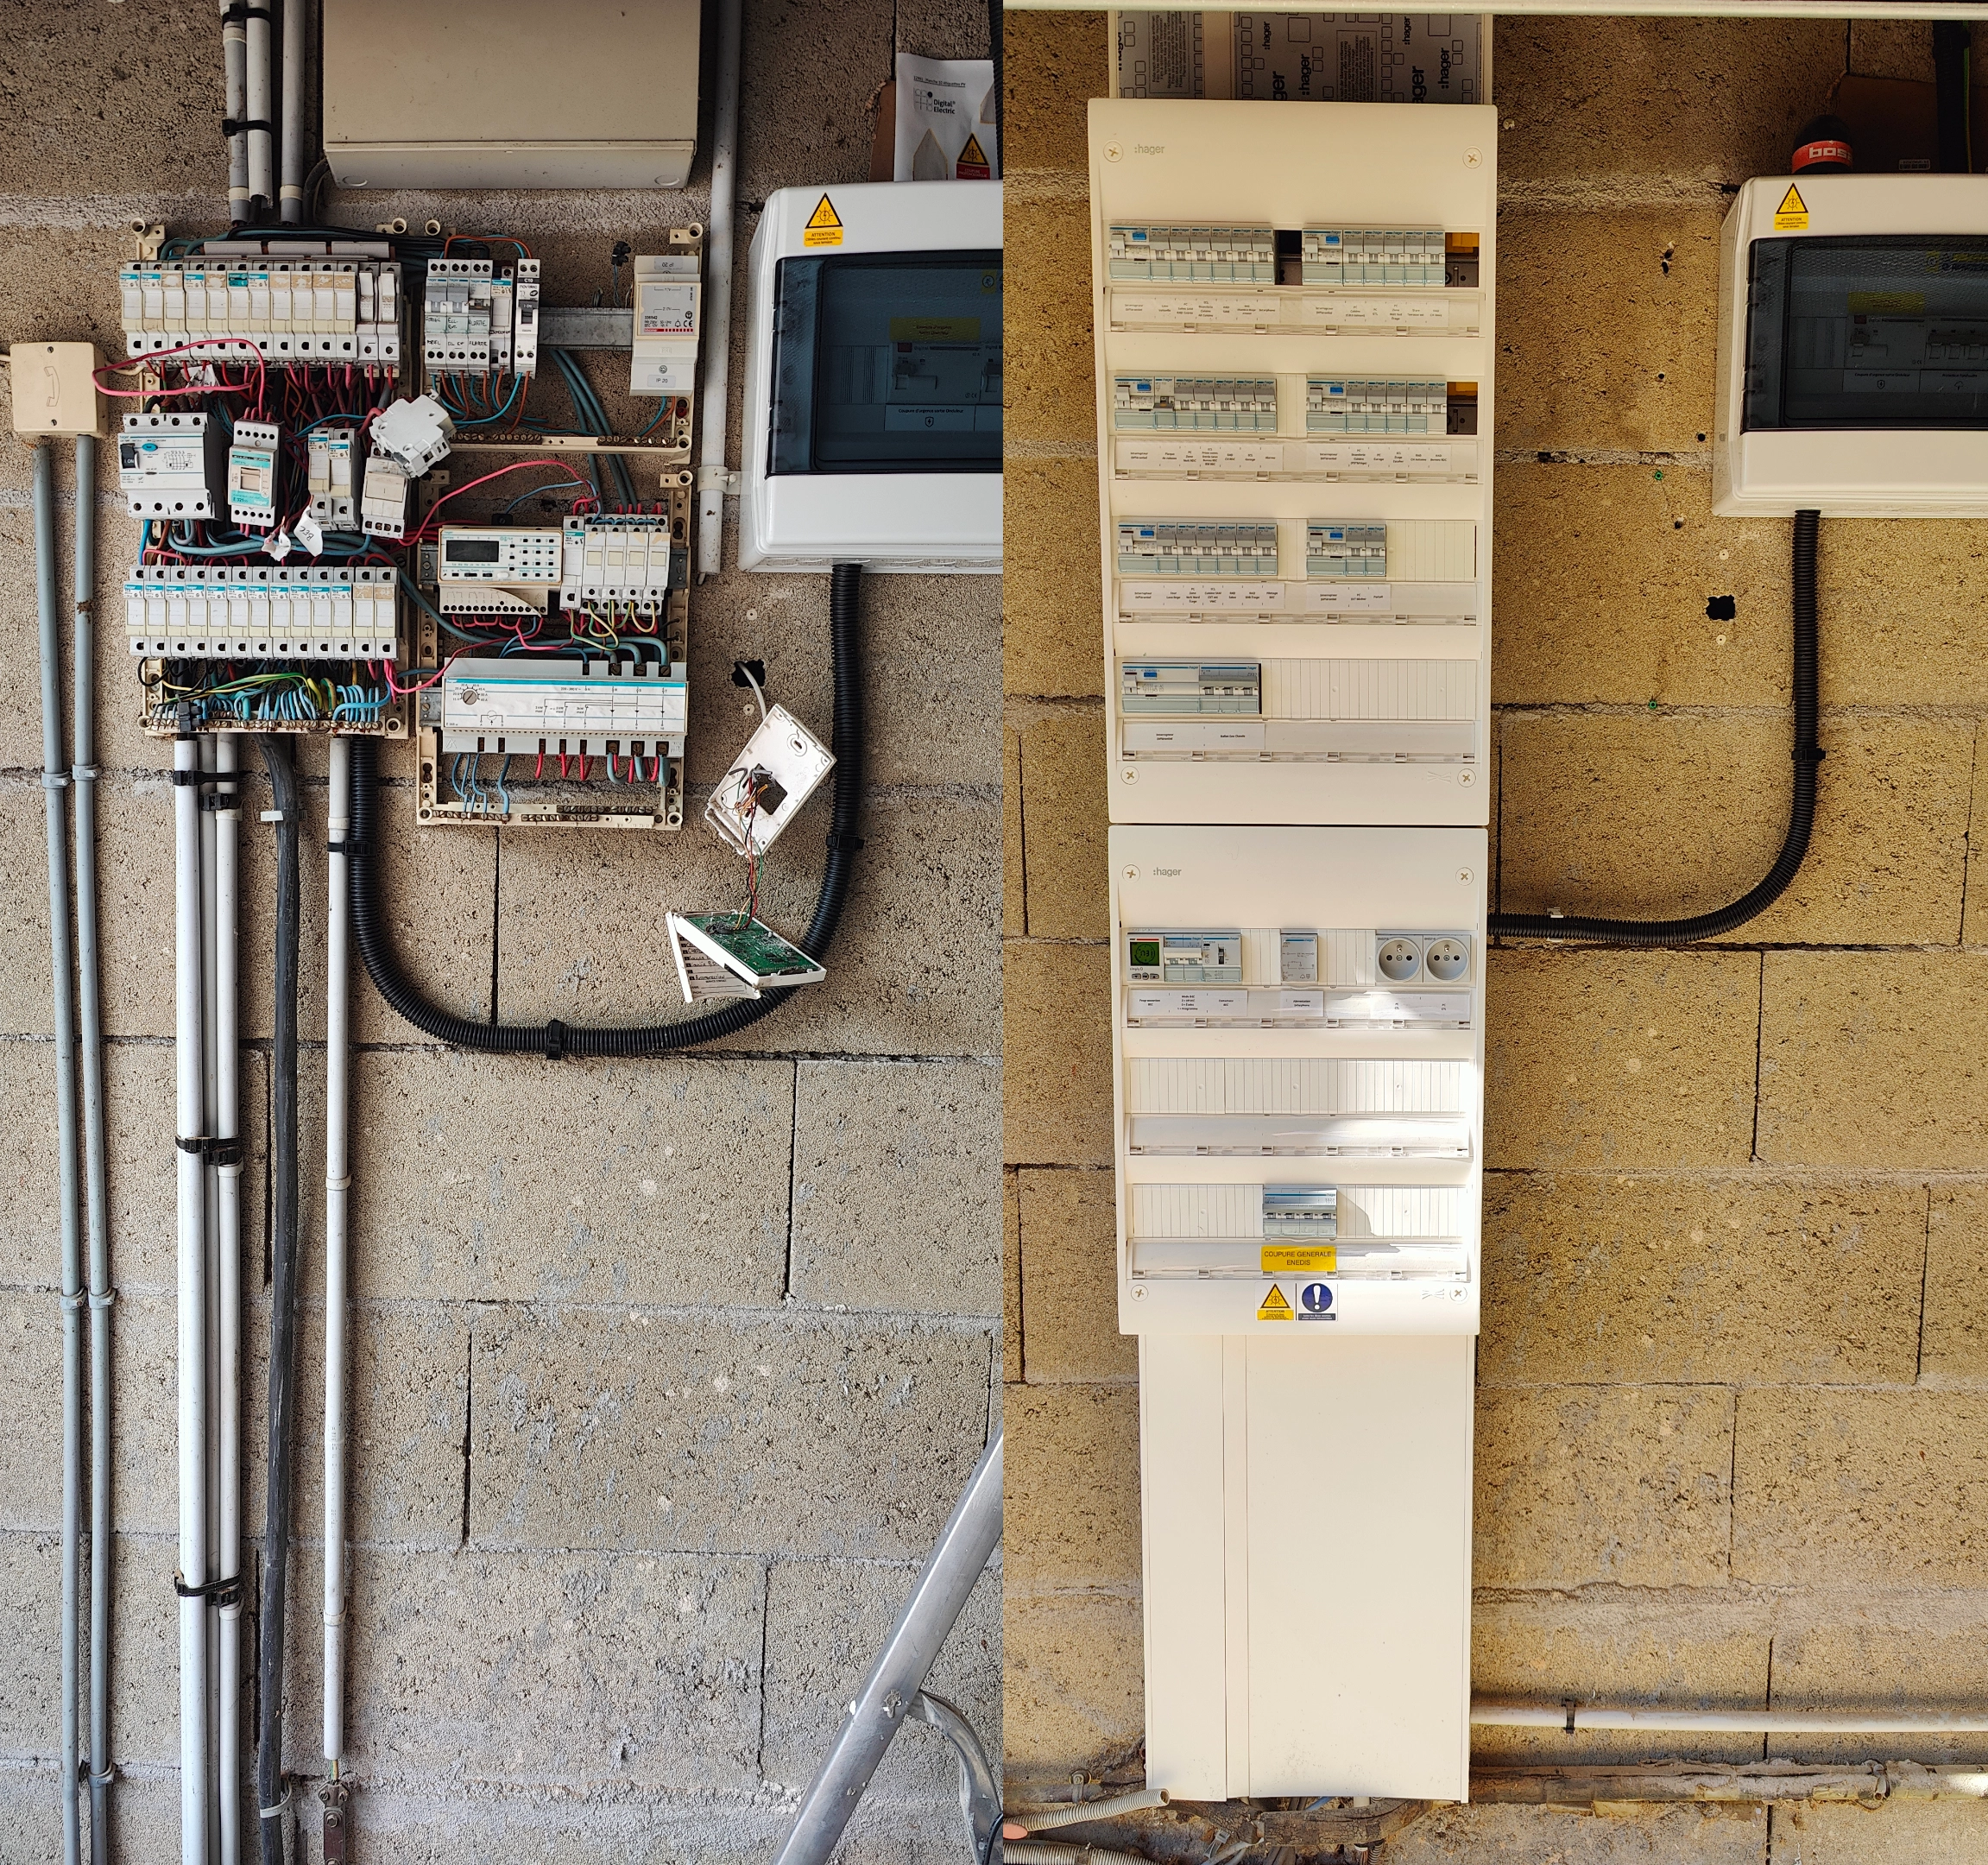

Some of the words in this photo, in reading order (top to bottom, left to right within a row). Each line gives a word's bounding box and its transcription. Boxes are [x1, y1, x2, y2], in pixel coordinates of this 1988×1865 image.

[1298, 54, 1311, 95] :hager
[1438, 48, 1451, 89] :hager
[1135, 144, 1165, 155] :hager
[1153, 867, 1182, 877] :hager
